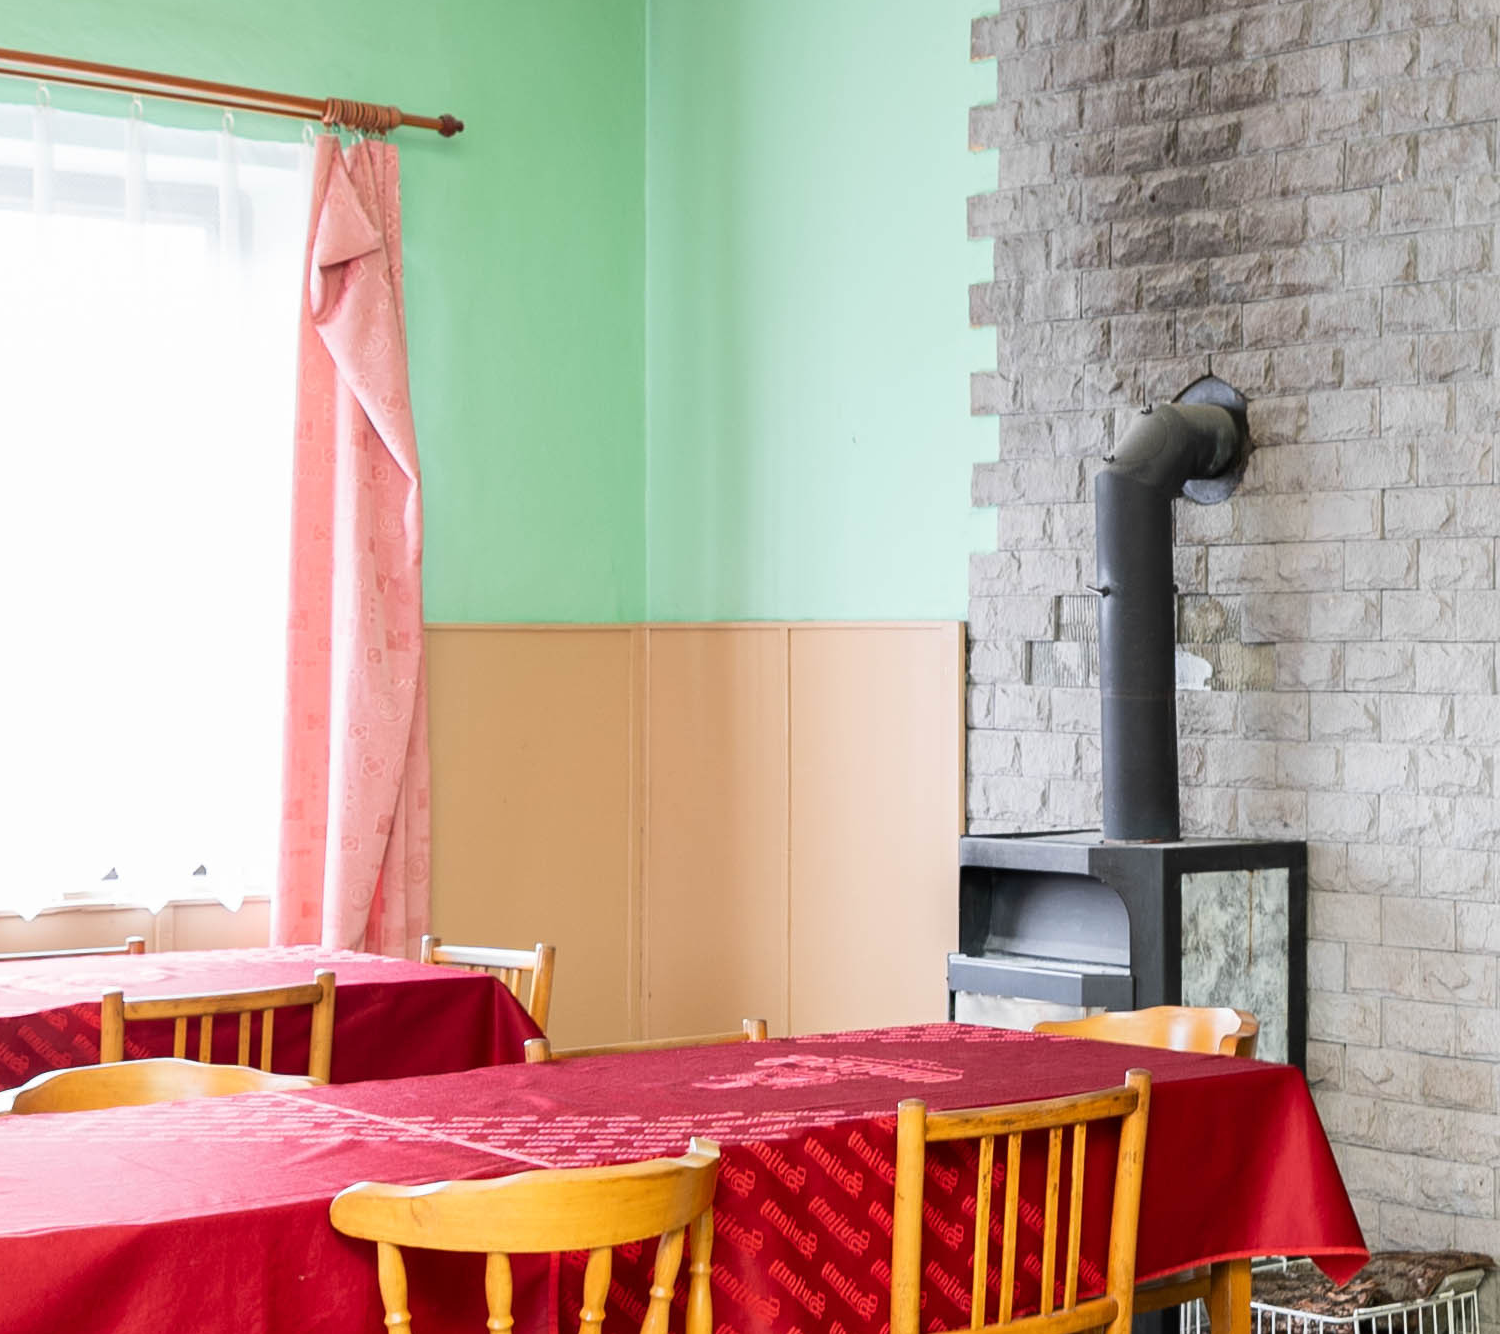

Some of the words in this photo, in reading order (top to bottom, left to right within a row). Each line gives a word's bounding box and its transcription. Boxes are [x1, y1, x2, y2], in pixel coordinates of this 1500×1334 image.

[804, 1136, 863, 1199] Svijany
[760, 1199, 818, 1261] Svijany
[808, 1196, 870, 1257] Svijany
[768, 1259, 826, 1320] Svijany
[821, 1261, 878, 1321] Svijany
